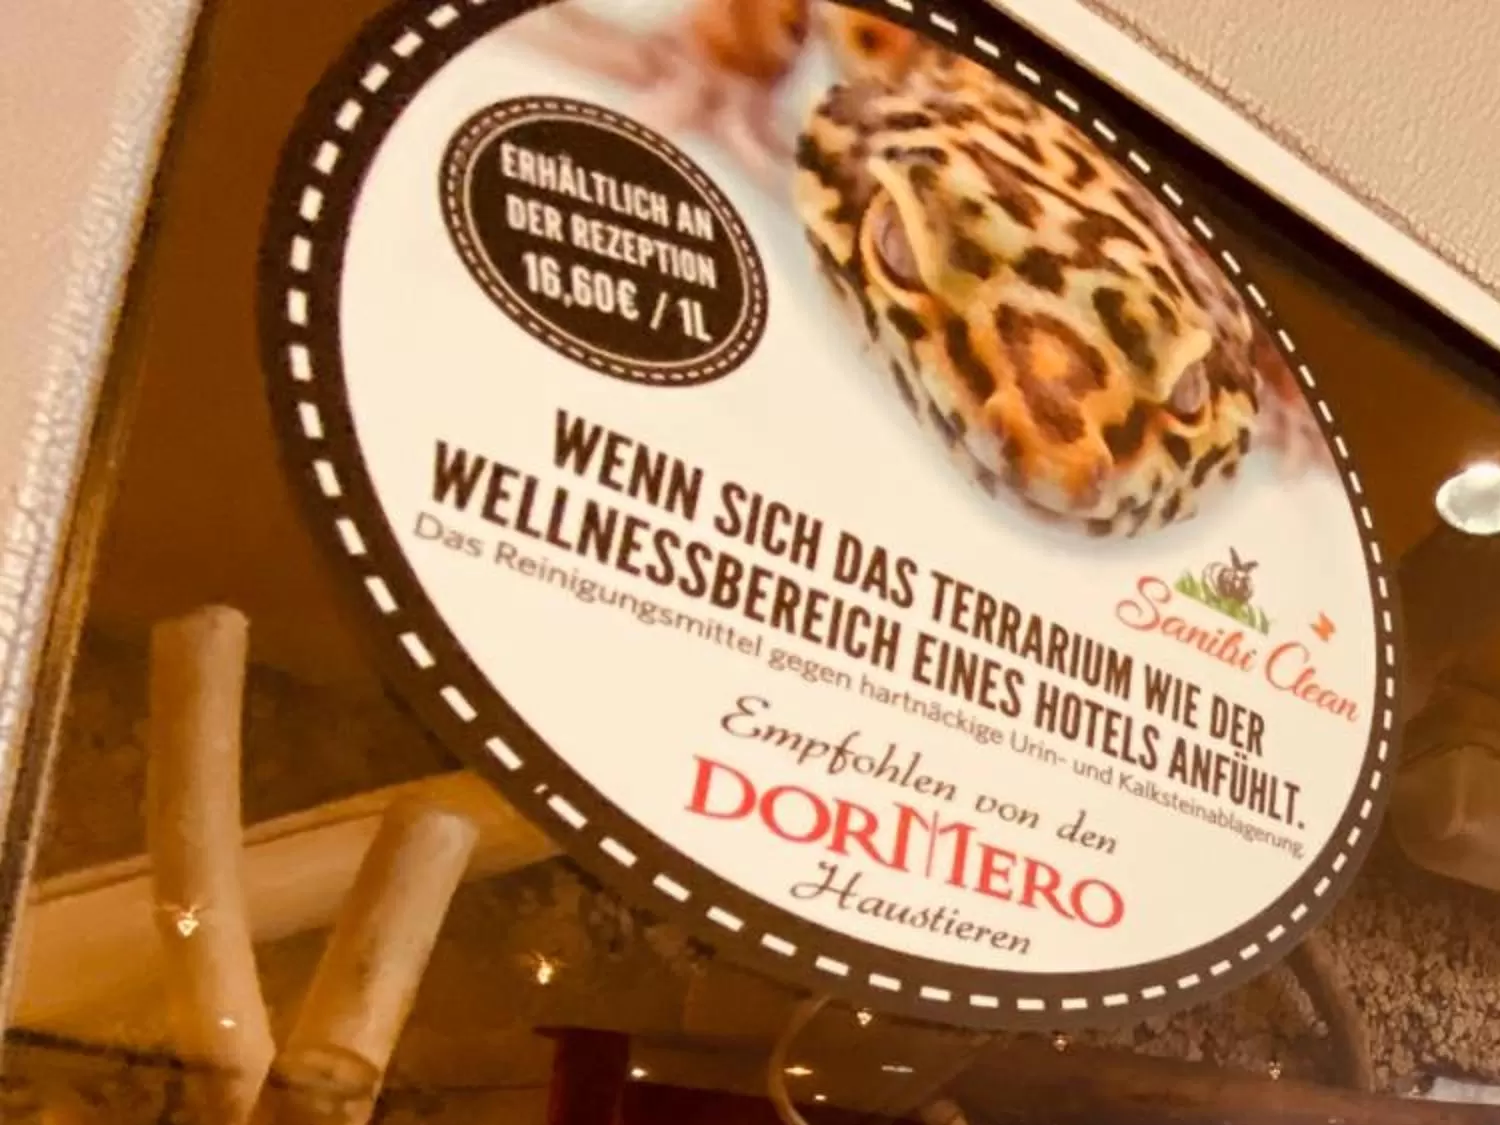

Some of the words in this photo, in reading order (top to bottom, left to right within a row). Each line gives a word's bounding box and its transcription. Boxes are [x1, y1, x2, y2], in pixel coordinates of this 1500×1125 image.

[501, 142, 669, 228] ERHÄLTLICH
[677, 201, 714, 241] AN
[506, 195, 563, 242] DER
[571, 215, 717, 289] REZEPTION
[650, 292, 669, 330] /
[679, 298, 713, 343] 1L
[432, 439, 901, 671] WELLNESSBEREICH
[912, 632, 1025, 719] EINES
[1034, 681, 1160, 772] HOTELS
[1168, 737, 1305, 830] ANFÜHLT.
[554, 408, 703, 521] WENN
[714, 482, 824, 571] SICH
[833, 531, 919, 609] DAS
[930, 570, 1134, 700] TERRARIUM
[1144, 663, 1201, 729] WIE
[1210, 694, 1265, 757] DER
[413, 511, 484, 558] Das
[493, 541, 764, 660] Reinigungsmittel
[767, 641, 853, 692] gegen
[858, 677, 1004, 746] hartnäckige
[1009, 730, 1067, 768] Urin-
[1073, 757, 1114, 786] und
[1265, 642, 1360, 722] Clean
[720, 695, 957, 803] Empfohlen
[974, 795, 1040, 830] von
[1056, 809, 1118, 855] den
[684, 755, 1126, 930] DORMERO
[789, 859, 1031, 957] Haustieren
